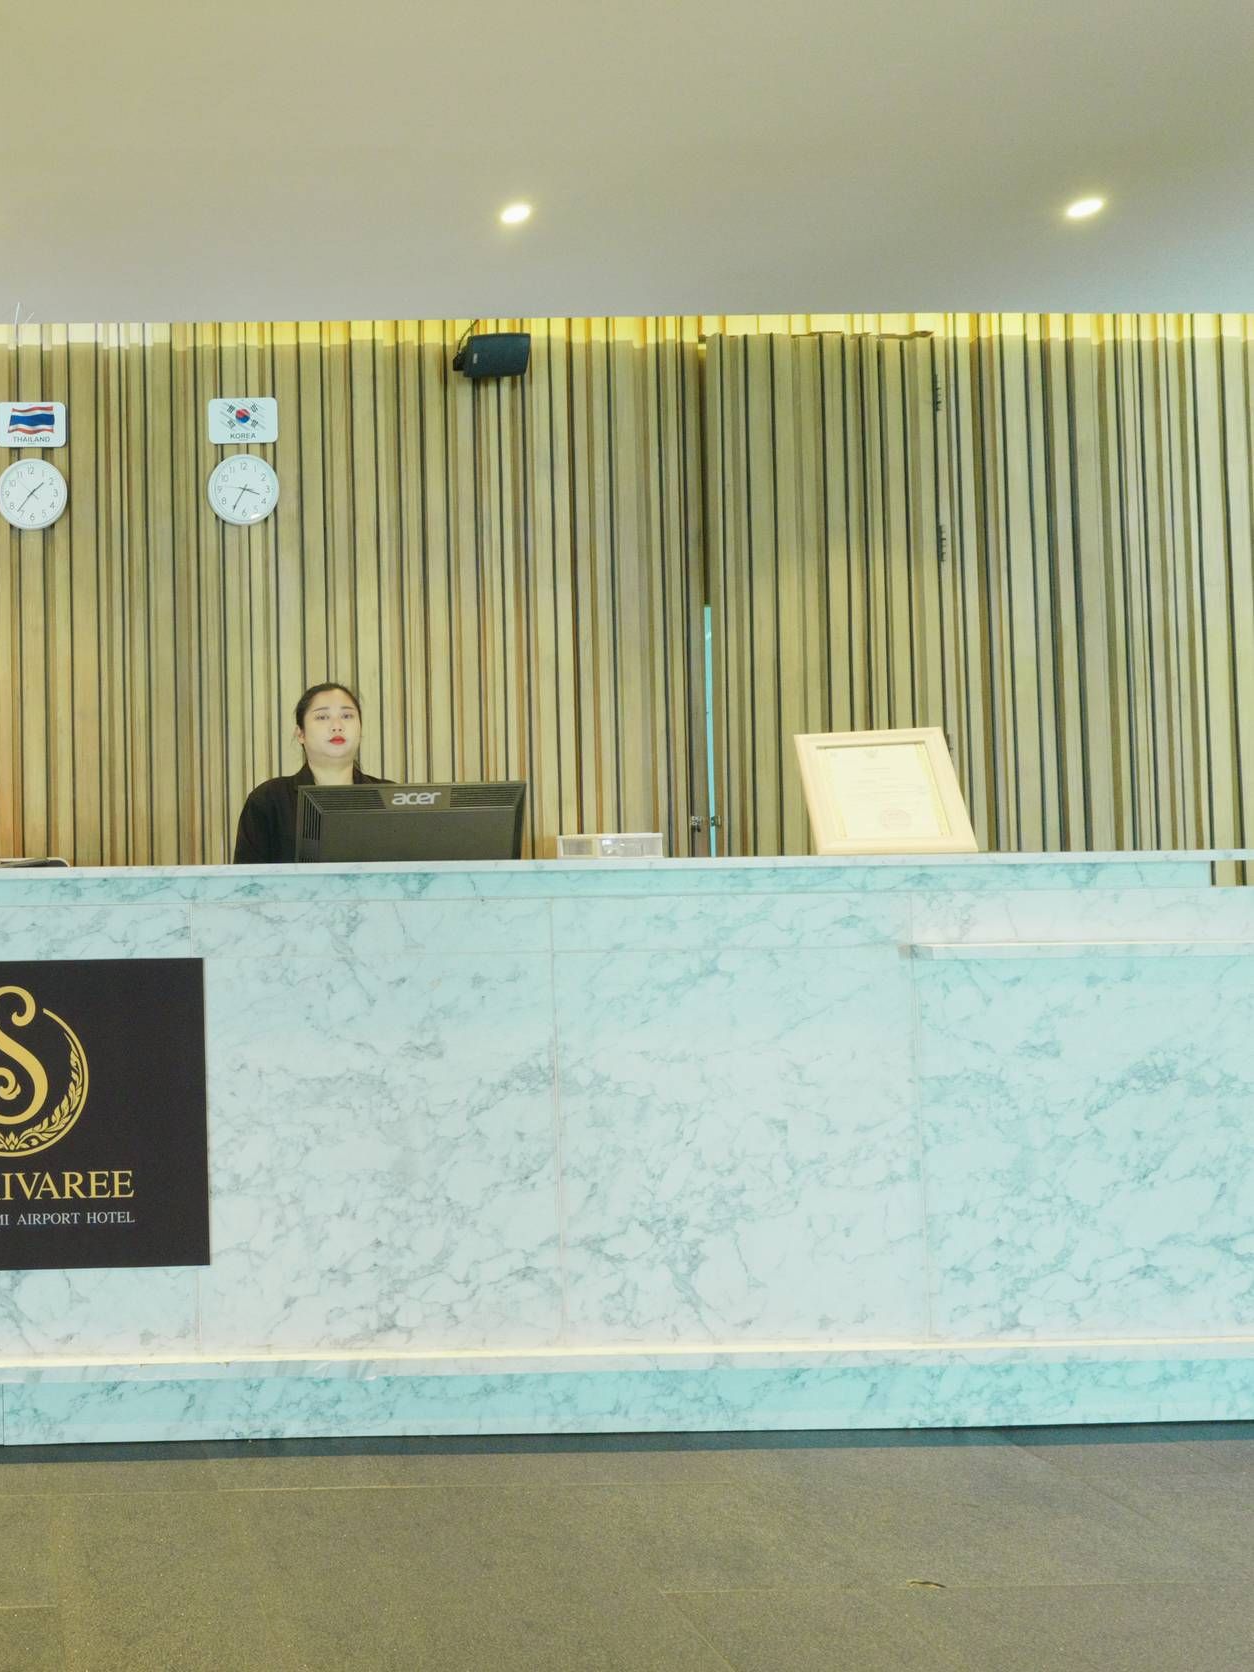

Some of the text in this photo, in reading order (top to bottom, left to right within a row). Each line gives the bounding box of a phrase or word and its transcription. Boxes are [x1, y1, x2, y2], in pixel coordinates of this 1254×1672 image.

[27, 466, 35, 475] 12
[240, 462, 248, 471] 12
[392, 791, 442, 805] acer
[16, 1212, 81, 1226] AIRPORT
[86, 1211, 136, 1225] HOTEL
